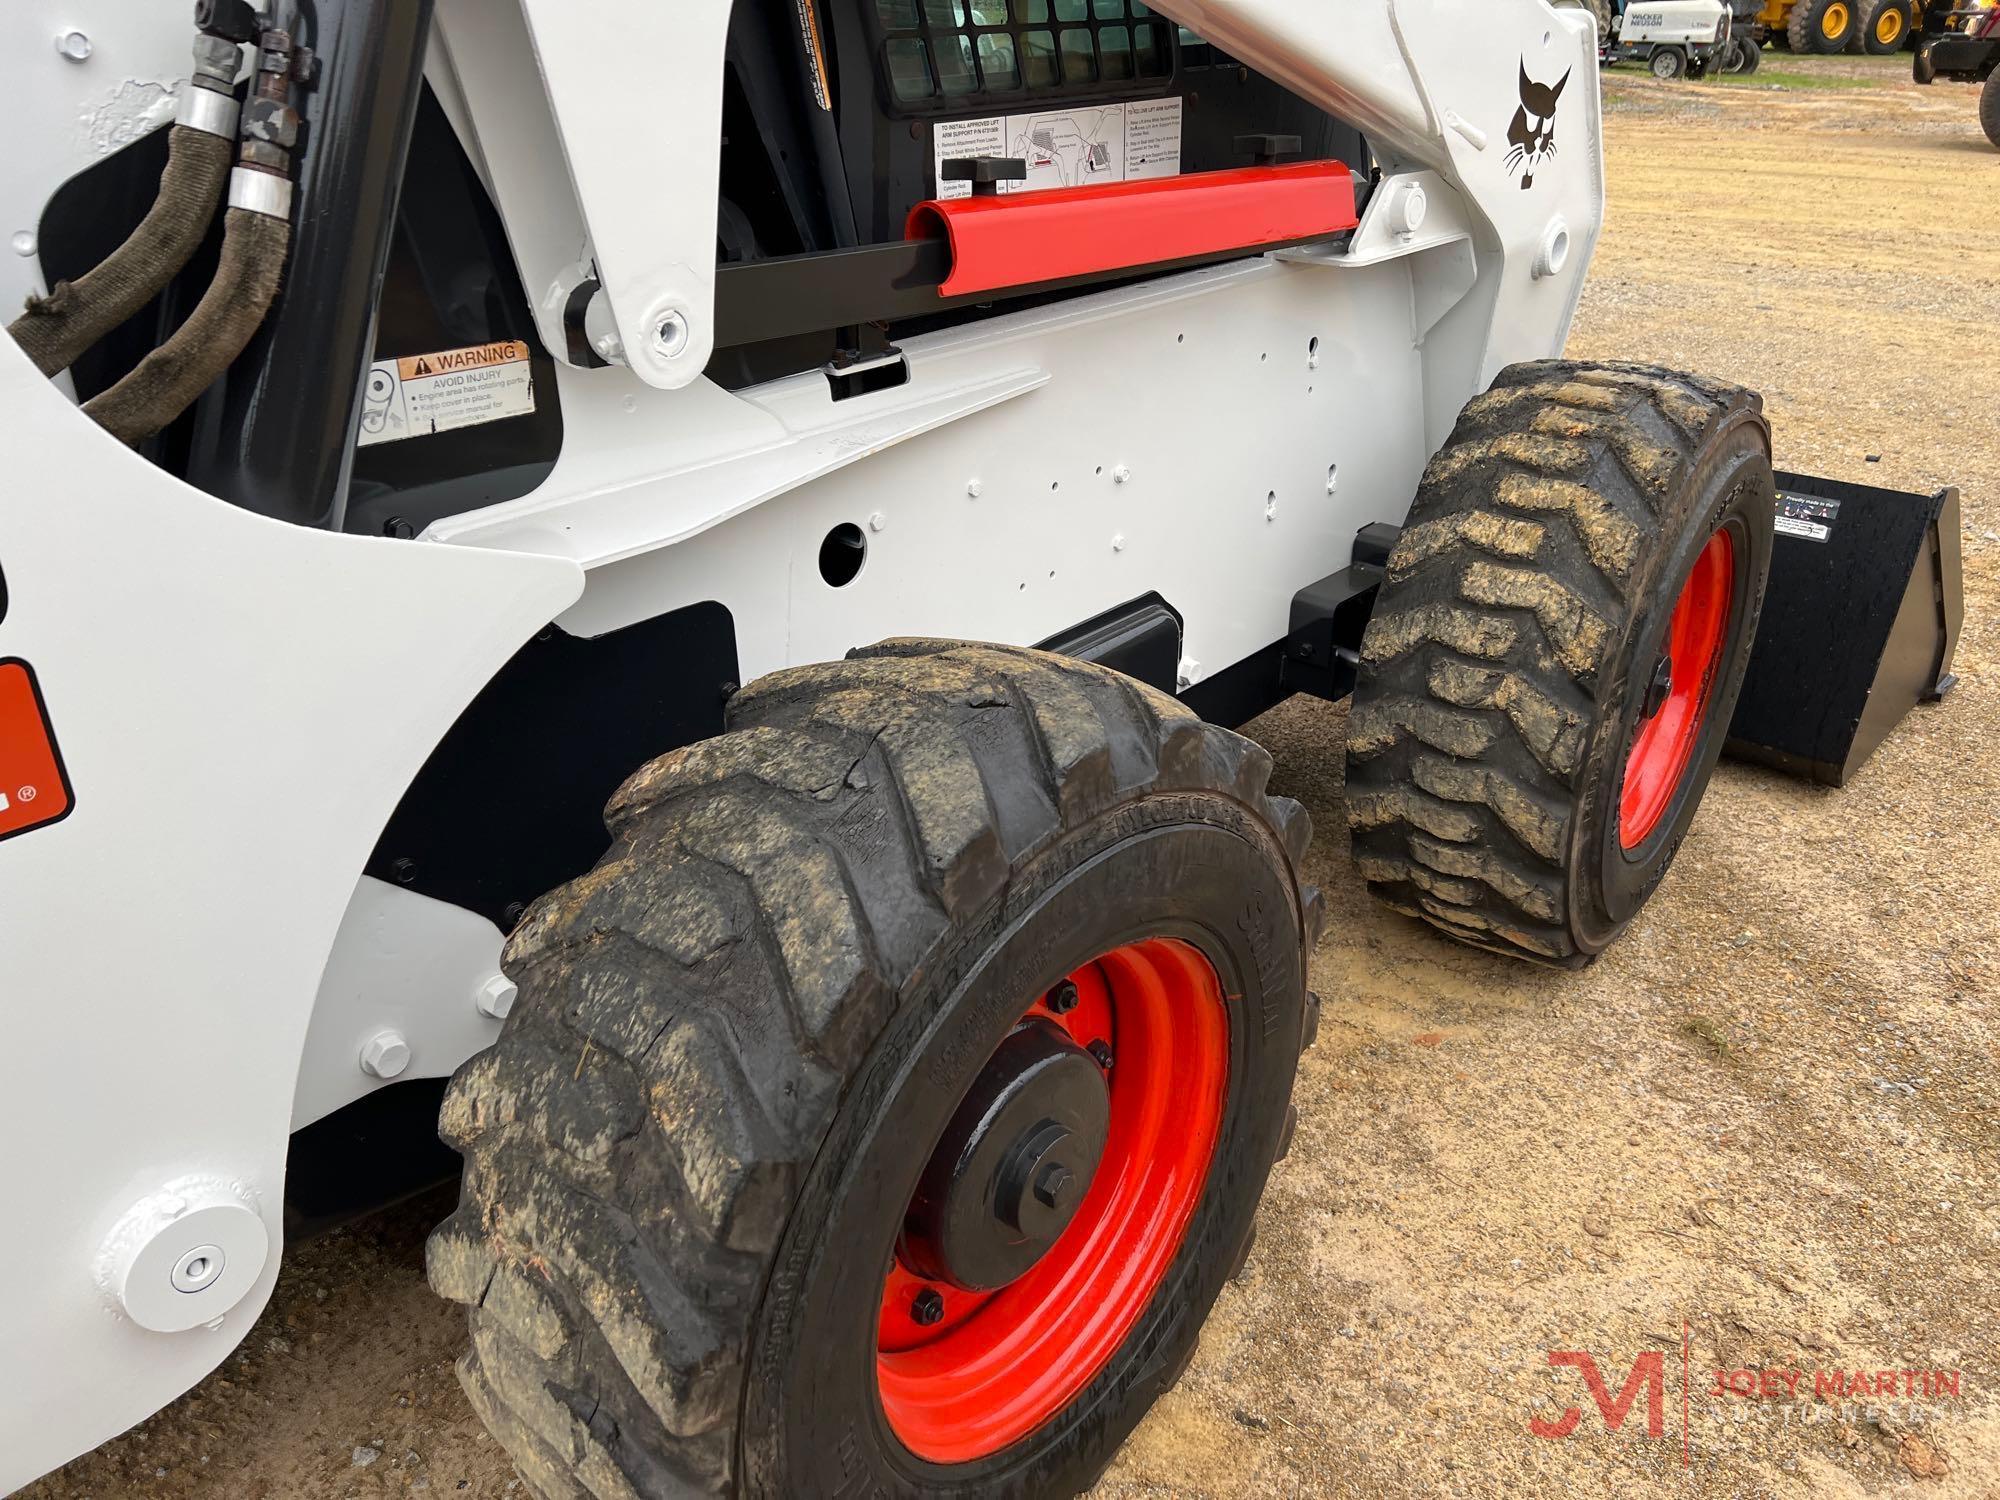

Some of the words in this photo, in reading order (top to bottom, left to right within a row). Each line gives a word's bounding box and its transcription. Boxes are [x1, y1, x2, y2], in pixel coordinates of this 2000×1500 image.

[967, 120, 990, 128] APPROVED
[438, 345, 516, 370] WARNING
[433, 376, 464, 389] AVOID
[467, 369, 502, 383] INJURY
[418, 390, 444, 402] Engine
[445, 388, 462, 396] area
[463, 384, 477, 393] has
[478, 380, 505, 391] rotating
[507, 377, 526, 388] parts.
[421, 402, 440, 413] Keep
[441, 398, 462, 409] cover
[464, 396, 470, 404] in
[472, 392, 493, 404] place.
[466, 403, 492, 415] manual
[493, 400, 503, 411] for
[1785, 504, 1827, 520] USA
